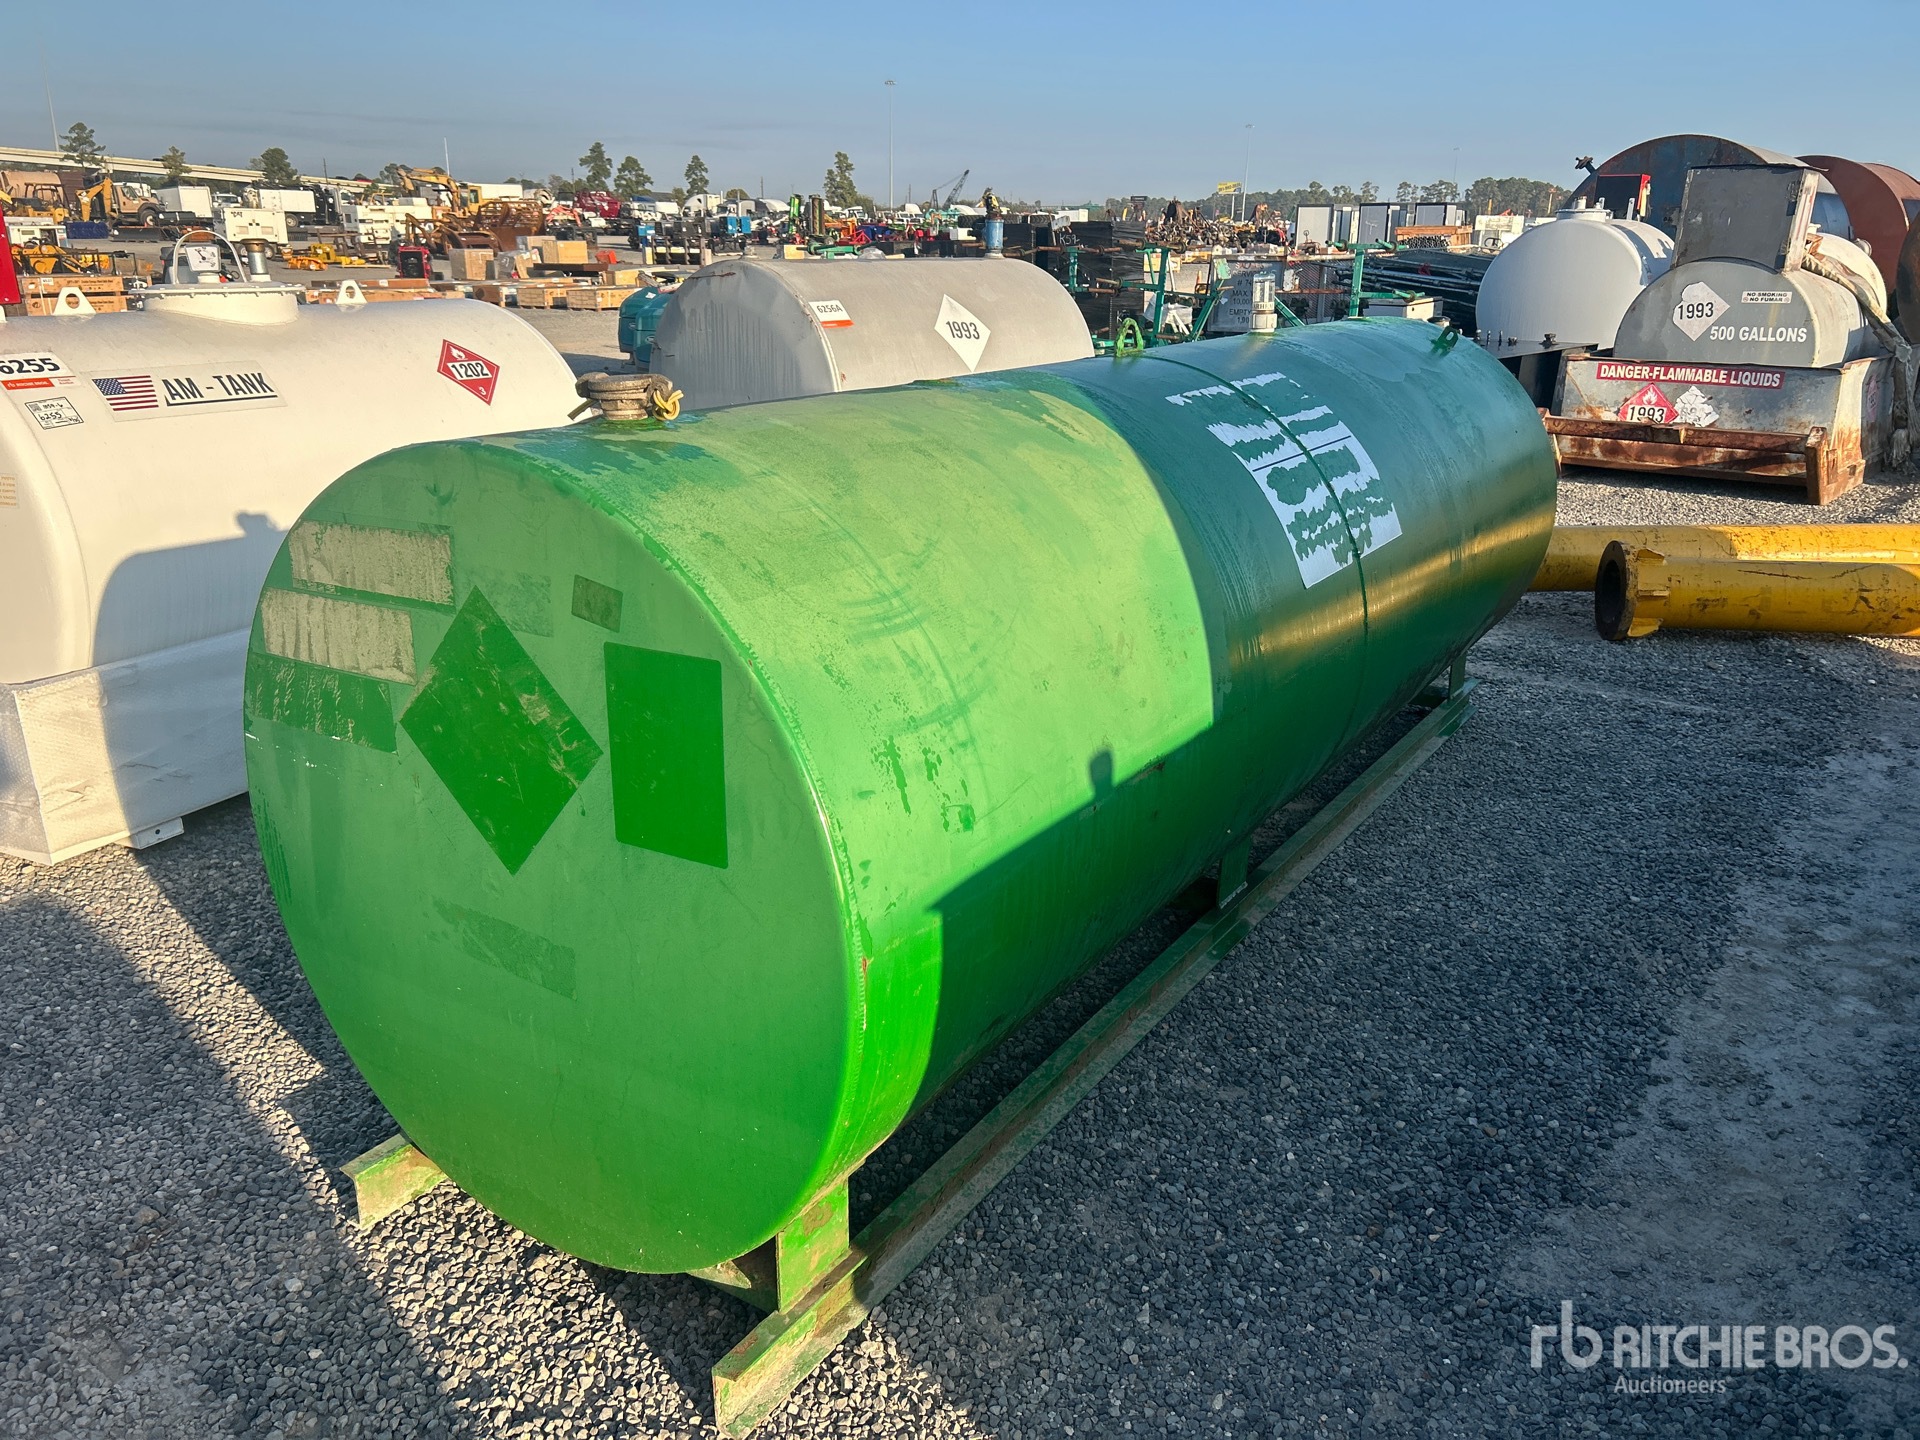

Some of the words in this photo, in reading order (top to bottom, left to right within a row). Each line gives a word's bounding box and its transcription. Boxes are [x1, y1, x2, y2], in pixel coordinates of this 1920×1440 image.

[1678, 301, 1714, 320] 1993
[945, 320, 980, 340] 1993
[1709, 326, 1735, 341] 500
[1739, 327, 1807, 343] GALLONS
[0, 358, 60, 375] 6255
[451, 362, 489, 378] 1202
[1600, 365, 1727, 383] DANGER-FLAMMABLE
[1729, 371, 1781, 387] LIQUIDS
[161, 377, 204, 401] AM
[212, 372, 275, 396] TANK
[478, 386, 487, 396] 3
[38, 411, 62, 421] 6255
[1629, 405, 1665, 423] 1993
